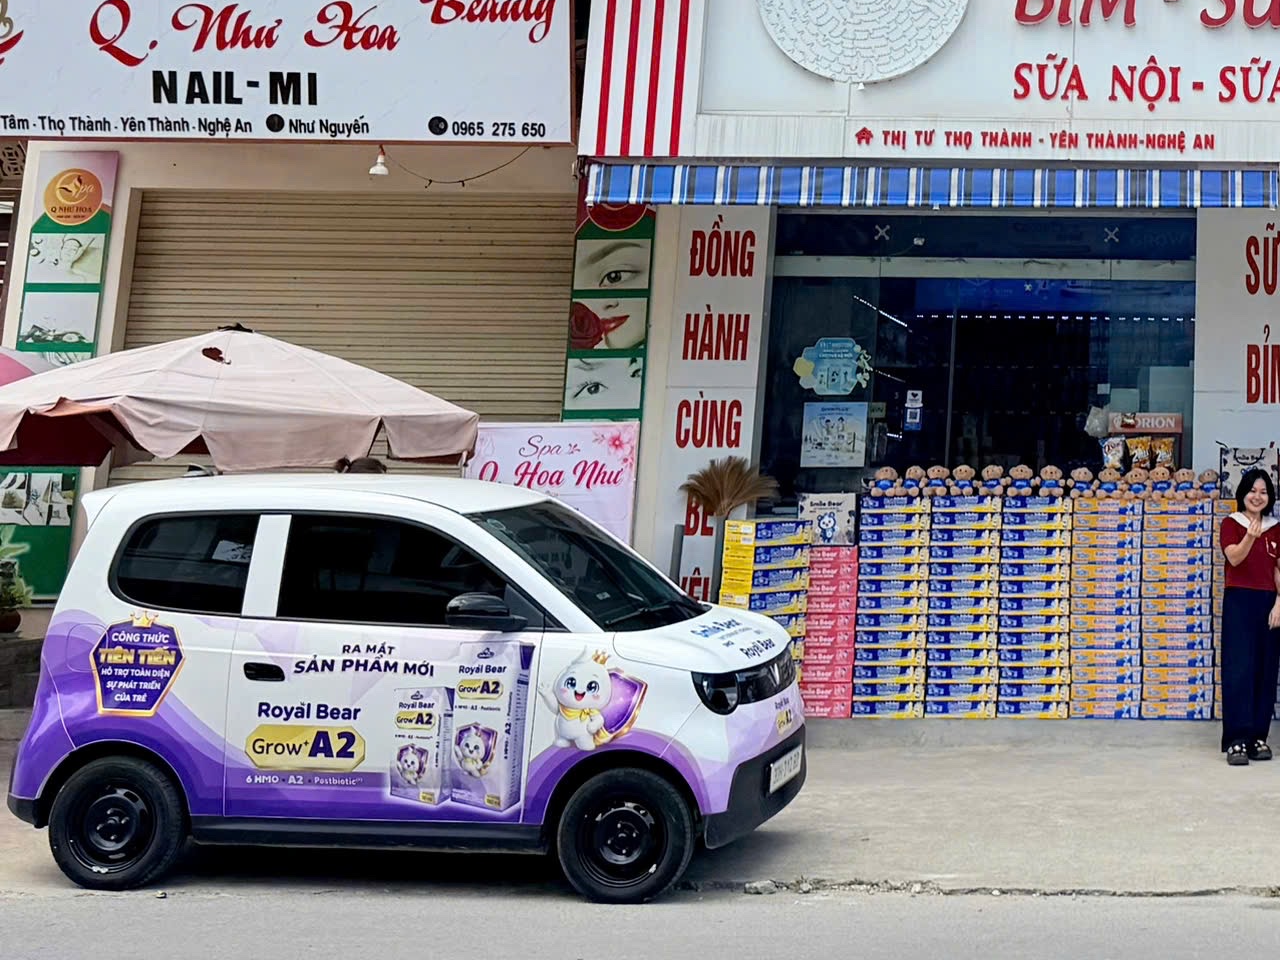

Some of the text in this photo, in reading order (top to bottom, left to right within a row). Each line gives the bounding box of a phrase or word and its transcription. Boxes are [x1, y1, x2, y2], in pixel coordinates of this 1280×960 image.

[173, 1, 281, 52] Như
[304, 0, 400, 53] Hoa
[1013, 53, 1088, 101] SỮA
[1108, 55, 1181, 112] NỘI
[0, 114, 29, 130] Tâm
[38, 116, 65, 135] Thọ
[69, 115, 111, 132] Thành
[120, 117, 146, 132] Yên
[148, 117, 189, 133] Thành
[198, 118, 231, 137] Nghệ
[235, 119, 252, 133] An
[289, 119, 317, 134] Như
[452, 122, 546, 137] 0965 275 650
[882, 130, 907, 150] THỊ
[915, 129, 935, 148] TƯ
[944, 130, 973, 150] THỌ
[980, 127, 1032, 149] THÀNH
[1050, 129, 1079, 149] YÊN
[1193, 132, 1215, 150] AN
[689, 214, 756, 277] ĐỒNG
[682, 304, 750, 361] HÀNH
[675, 391, 742, 449] CÙNG
[519, 435, 563, 460] Spa
[514, 461, 565, 489] Hoa
[573, 459, 623, 490] Như
[112, 631, 169, 643] CÔNG THỨC
[99, 646, 135, 664] TIÊN
[342, 642, 396, 656] RA MẮT
[131, 667, 151, 677] TOÀN
[152, 668, 170, 679] DIỆN
[294, 653, 434, 677] SẢN PHẨM MỚI
[459, 665, 507, 675] Royal Bear
[118, 680, 137, 689] PHÁT
[480, 681, 500, 694] A2
[114, 692, 131, 702] CỦA
[398, 701, 417, 710] Royal
[258, 702, 360, 722] Royal Bear
[415, 713, 433, 725] A2
[309, 731, 356, 758] A2
[245, 775, 252, 784] 6
[254, 775, 279, 784] HMO
[288, 775, 304, 784] A2
